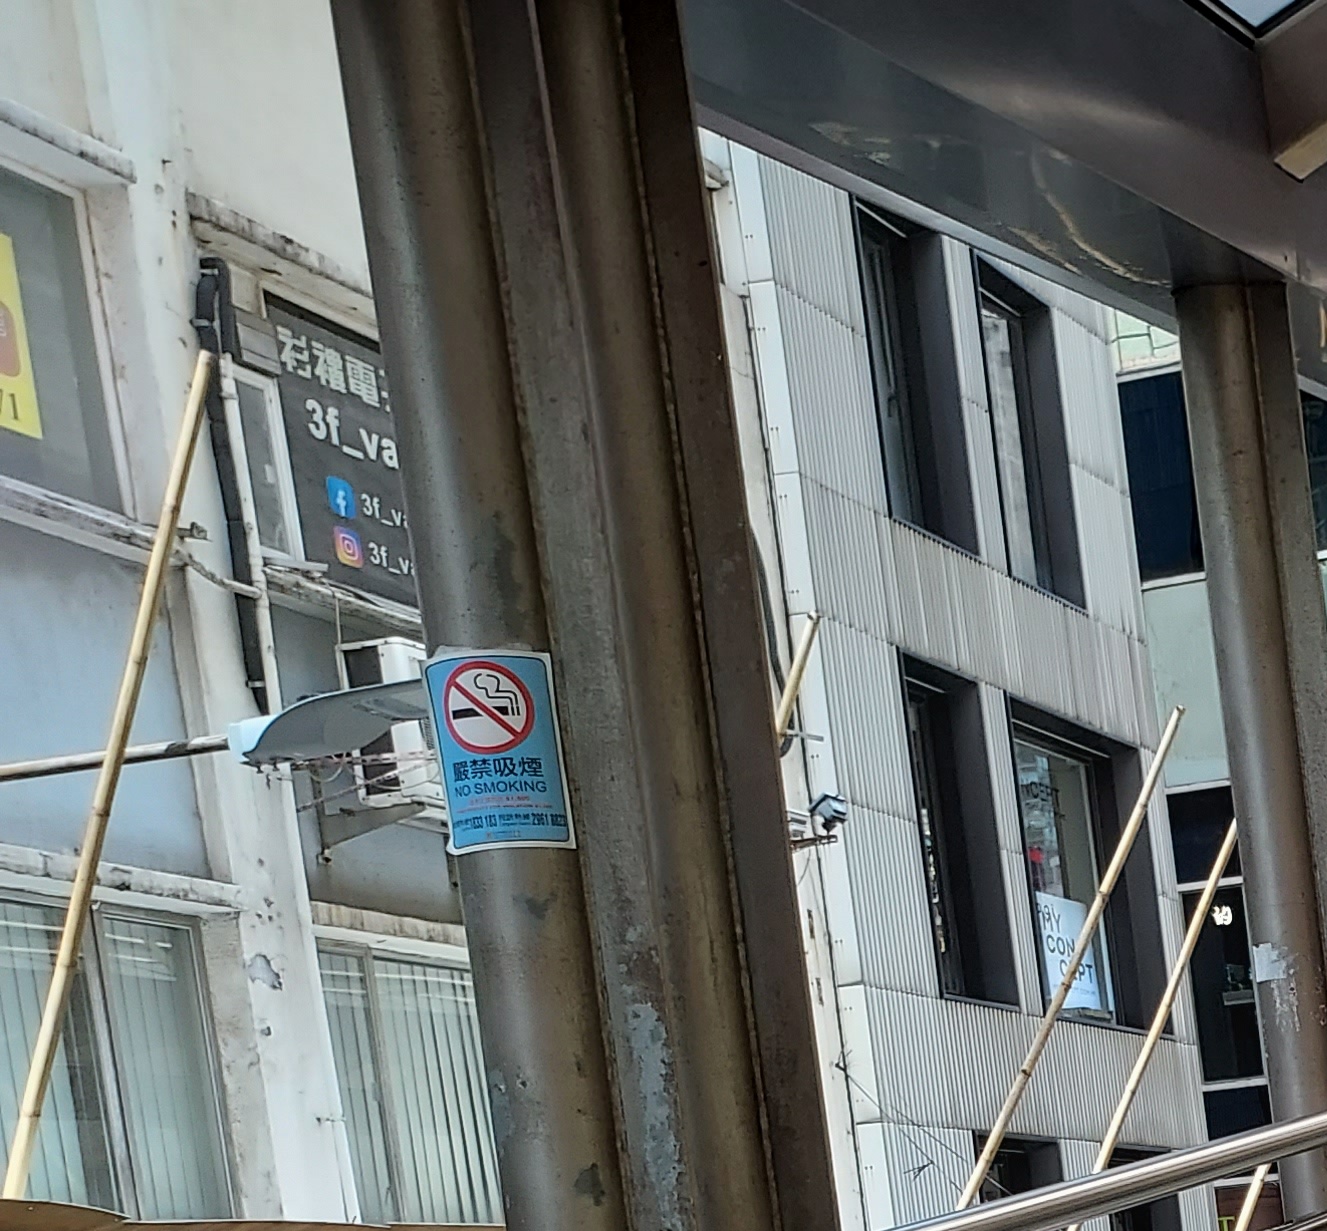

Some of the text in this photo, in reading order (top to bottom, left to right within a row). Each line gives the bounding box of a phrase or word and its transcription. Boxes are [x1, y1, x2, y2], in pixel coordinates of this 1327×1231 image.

[453, 757, 544, 783] 嚴禁吸煙
[455, 780, 547, 798] NO SMOKING
